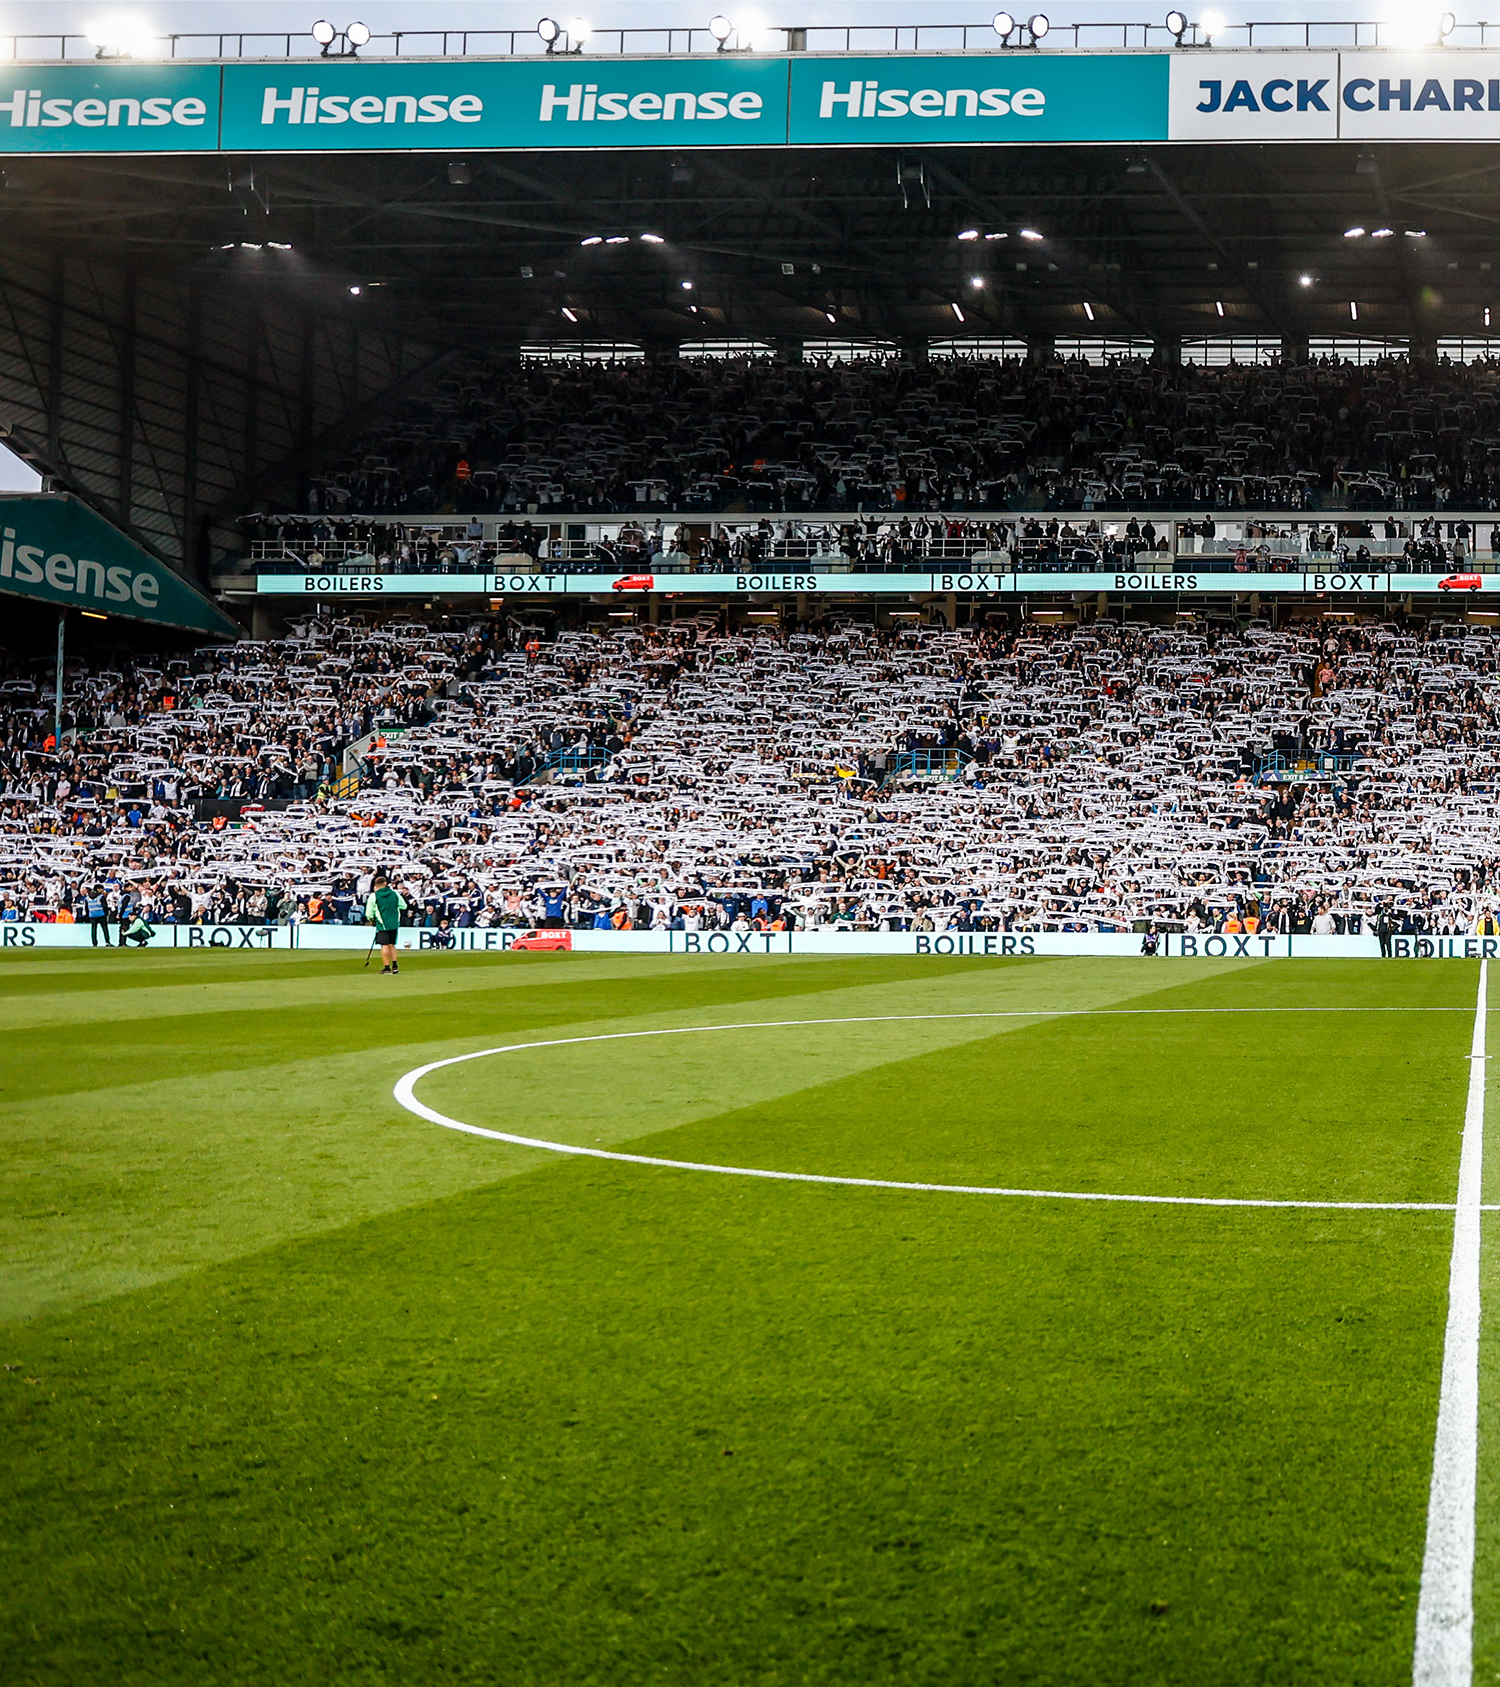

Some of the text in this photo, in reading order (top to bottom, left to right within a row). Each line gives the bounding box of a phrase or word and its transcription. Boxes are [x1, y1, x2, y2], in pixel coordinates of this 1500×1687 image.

[539, 84, 763, 122] Hisense
[819, 81, 1046, 118] Hisense
[1196, 78, 1330, 113] JACK
[0, 89, 207, 127] Hisense
[261, 87, 483, 125] Hisense
[0, 526, 159, 608] isense
[304, 577, 384, 591] BOILERS
[494, 575, 558, 591] BOXT
[736, 576, 818, 590] BOILERS
[941, 575, 1006, 590] BOXT
[1115, 575, 1198, 590] BOILERS
[1314, 574, 1379, 590] BOXT
[189, 927, 278, 948] BOXT
[542, 931, 567, 939] BOXT
[685, 933, 776, 953] BOXT
[916, 935, 1035, 955] BOILERS
[1181, 935, 1276, 957] BOXT
